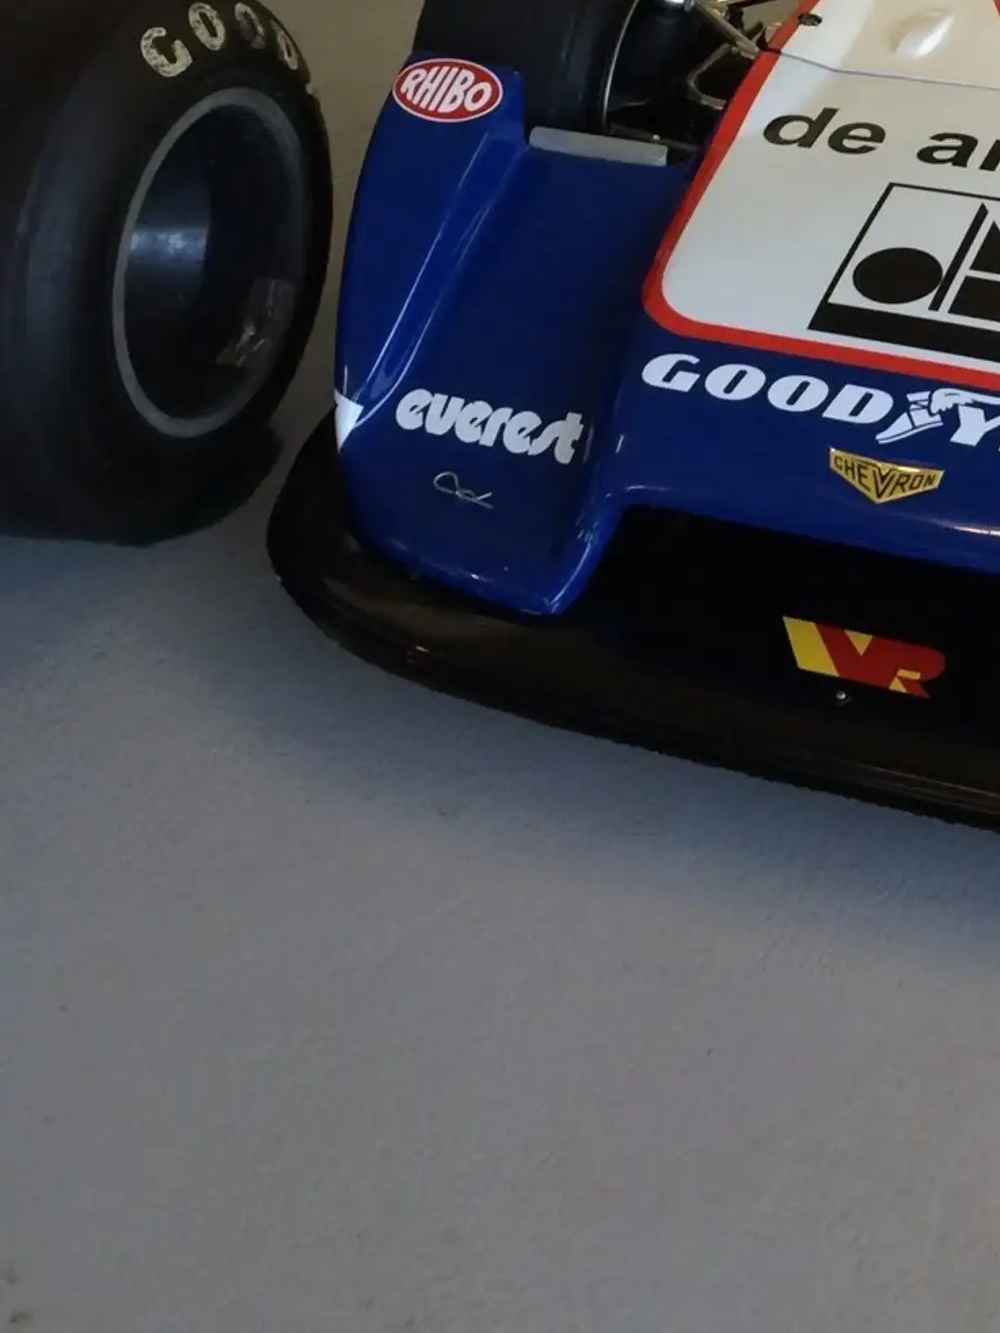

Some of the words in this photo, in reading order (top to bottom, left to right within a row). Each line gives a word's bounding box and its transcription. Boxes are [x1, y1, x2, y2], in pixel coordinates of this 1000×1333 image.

[400, 67, 494, 114] RHIBO
[763, 107, 886, 155] de
[396, 389, 585, 465] everest
[832, 452, 940, 500] CHEVRON
